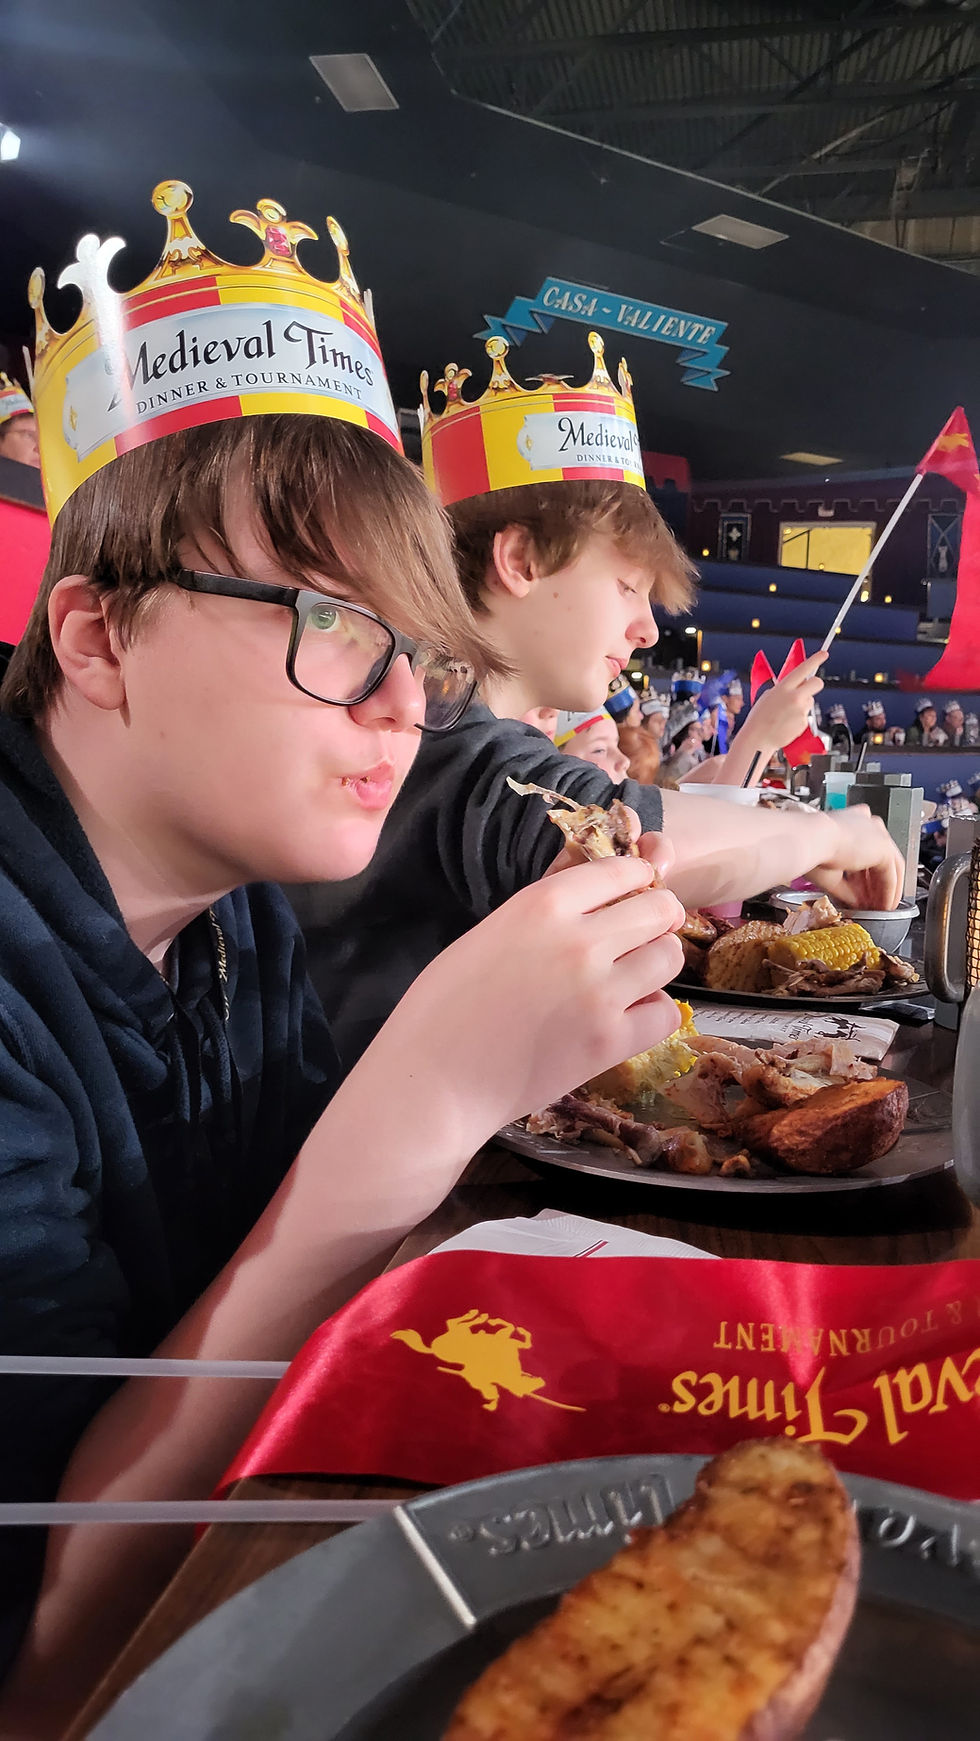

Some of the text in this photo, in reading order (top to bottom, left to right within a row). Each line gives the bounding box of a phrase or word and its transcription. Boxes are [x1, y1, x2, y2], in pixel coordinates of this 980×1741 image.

[543, 286, 598, 317] CASA
[616, 304, 716, 345] VALIENTE
[283, 320, 374, 386] Times
[136, 372, 362, 414] DINNER & TOURNAMENT
[558, 417, 634, 452] Medieval
[577, 454, 613, 463] DINNER
